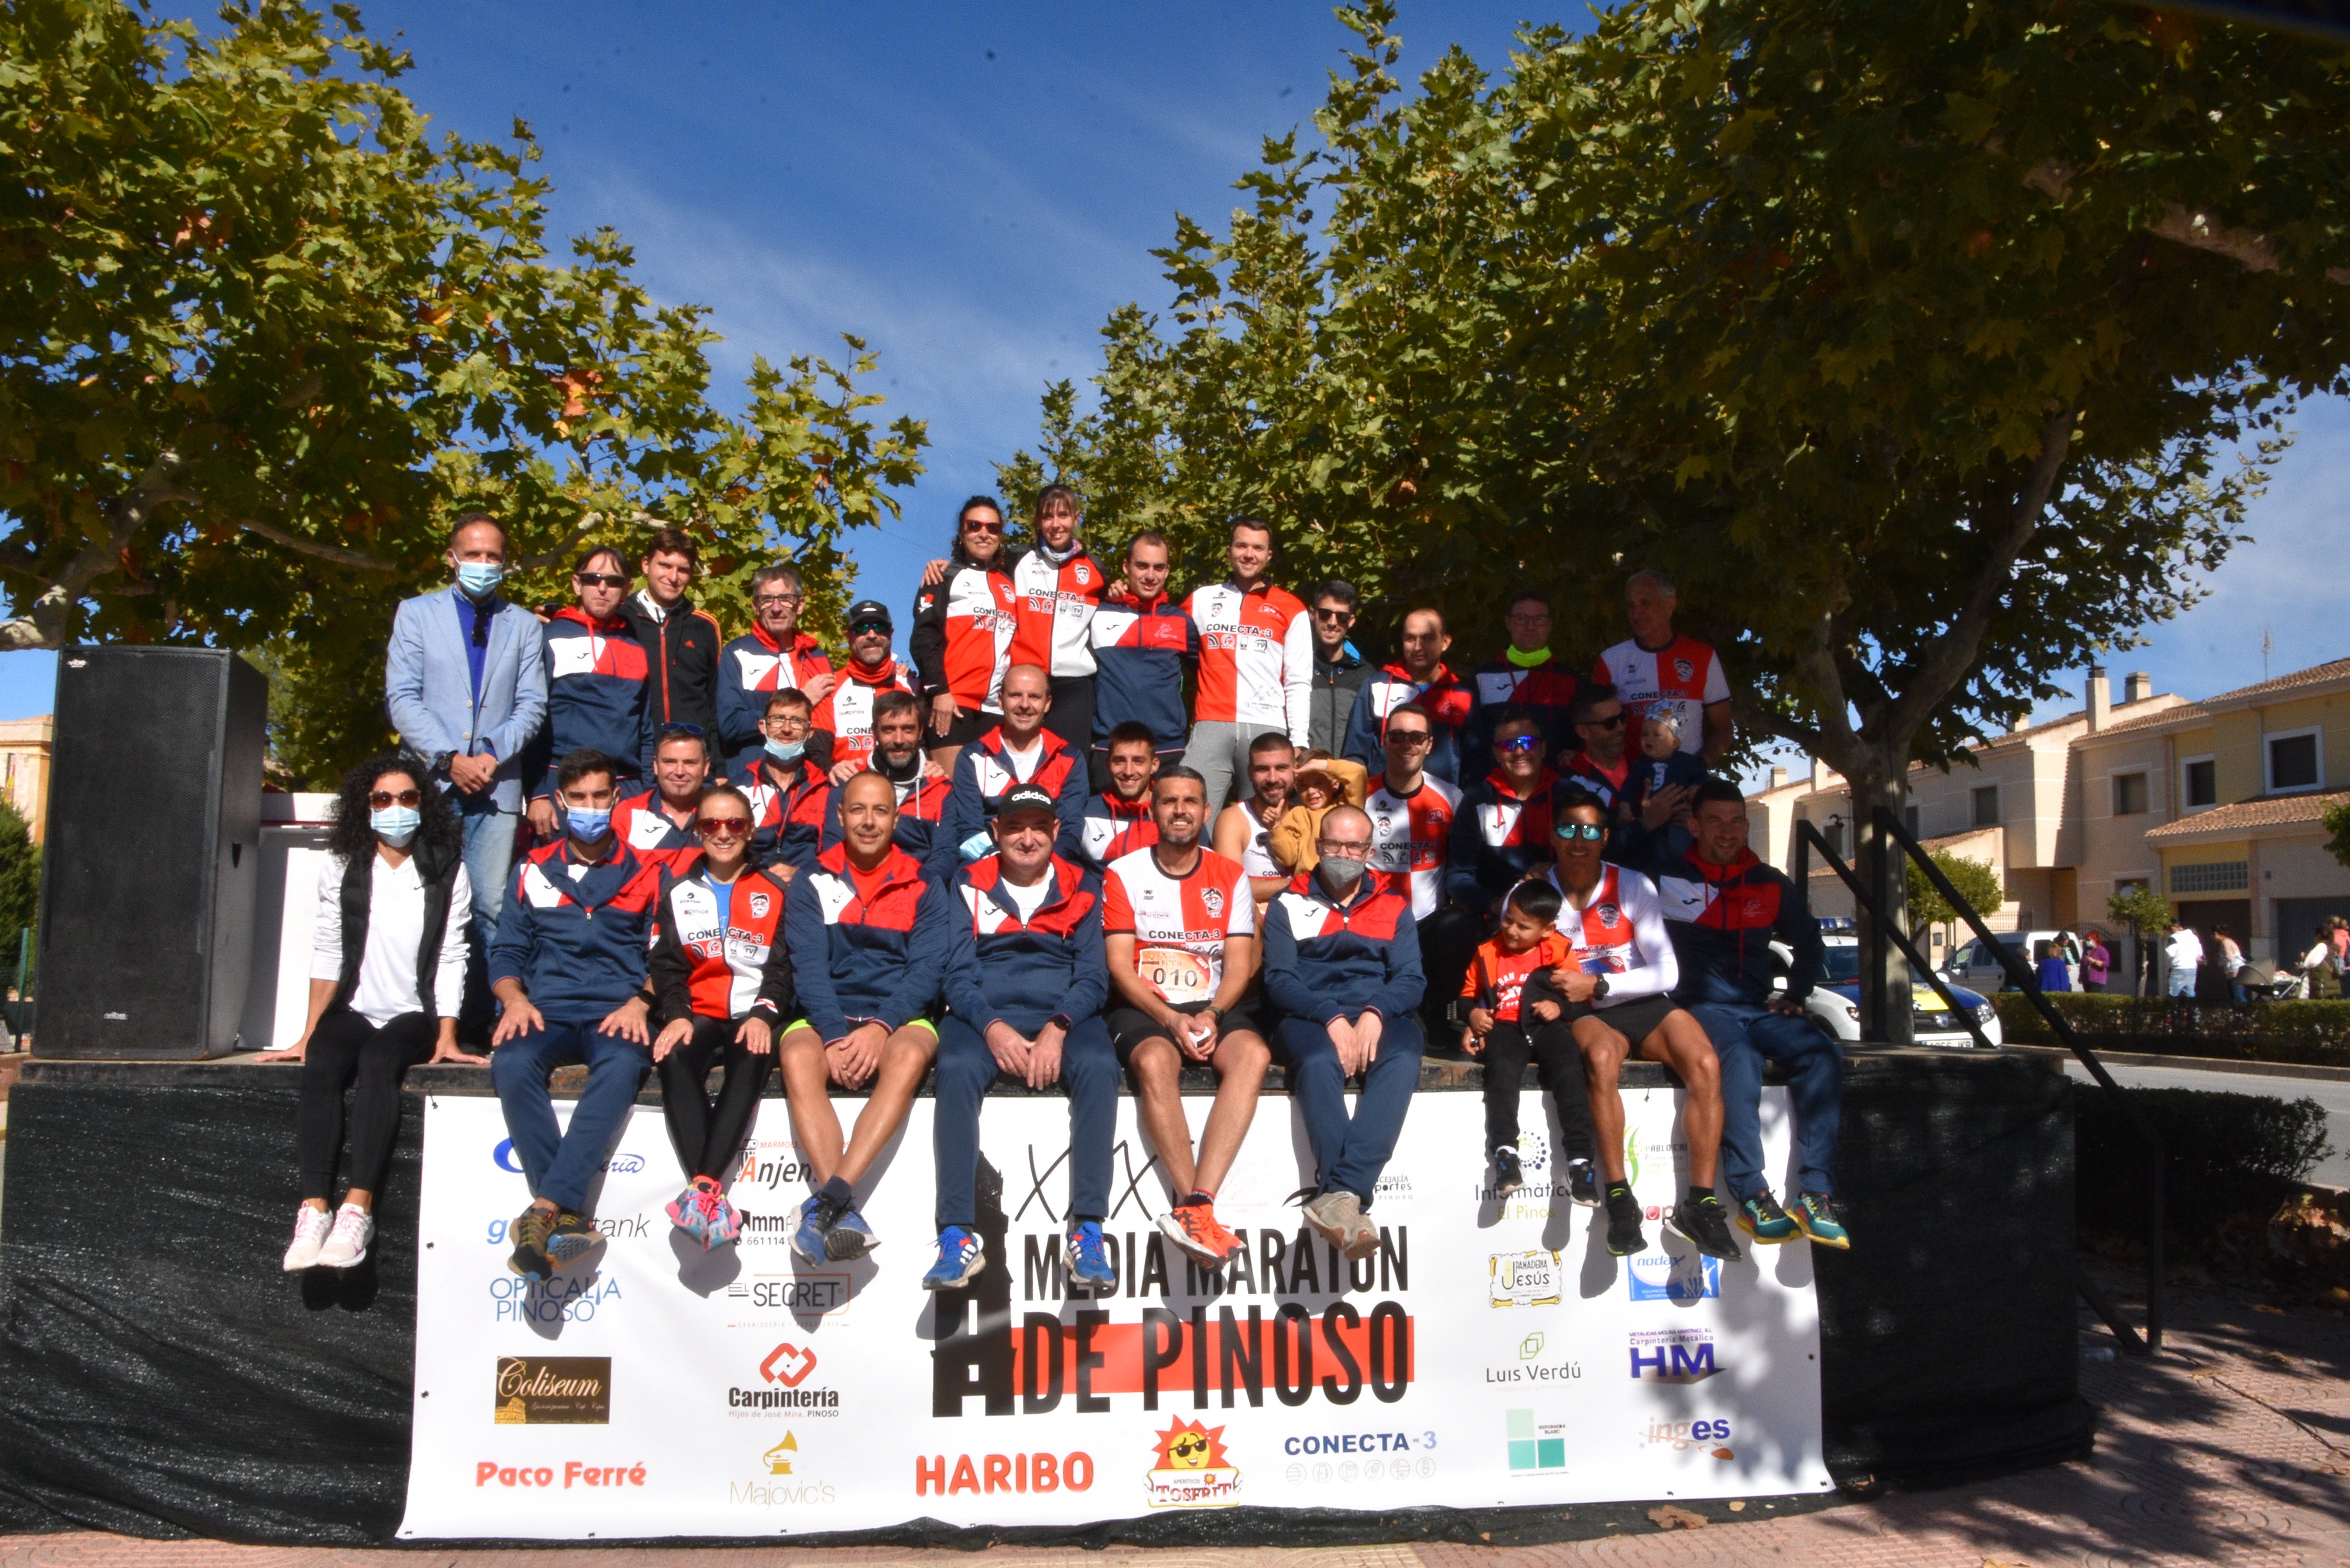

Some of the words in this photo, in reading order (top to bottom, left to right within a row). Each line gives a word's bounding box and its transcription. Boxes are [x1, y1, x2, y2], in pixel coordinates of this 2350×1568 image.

[1207, 624, 1272, 637] CONECTA-3
[1011, 790, 1051, 805] adidas
[1149, 929, 1220, 940] CONECTA-3
[1153, 968, 1198, 987] 010
[1498, 1205, 1510, 1220] El
[1517, 1203, 1556, 1219] Pinós
[1501, 1261, 1550, 1290] JESÚS
[753, 1282, 840, 1307] SECRET
[496, 1300, 595, 1322] PINOSO
[1022, 1309, 1111, 1414] DE
[1143, 1299, 1409, 1412] PINOSO
[1629, 1343, 1716, 1378] HM
[497, 1357, 602, 1397] Coliseum
[1526, 1361, 1581, 1380] Verdú
[729, 1386, 839, 1410] Carpintería
[764, 1410, 781, 1418] José
[807, 1410, 839, 1418] PINOSO
[1648, 1416, 1731, 1451] inges
[476, 1461, 554, 1487] Paco
[564, 1461, 647, 1490] Ferré
[916, 1451, 1094, 1497] HARIBO
[730, 1480, 836, 1511] Majovic's
[1156, 1483, 1231, 1502] TOSFRIT
